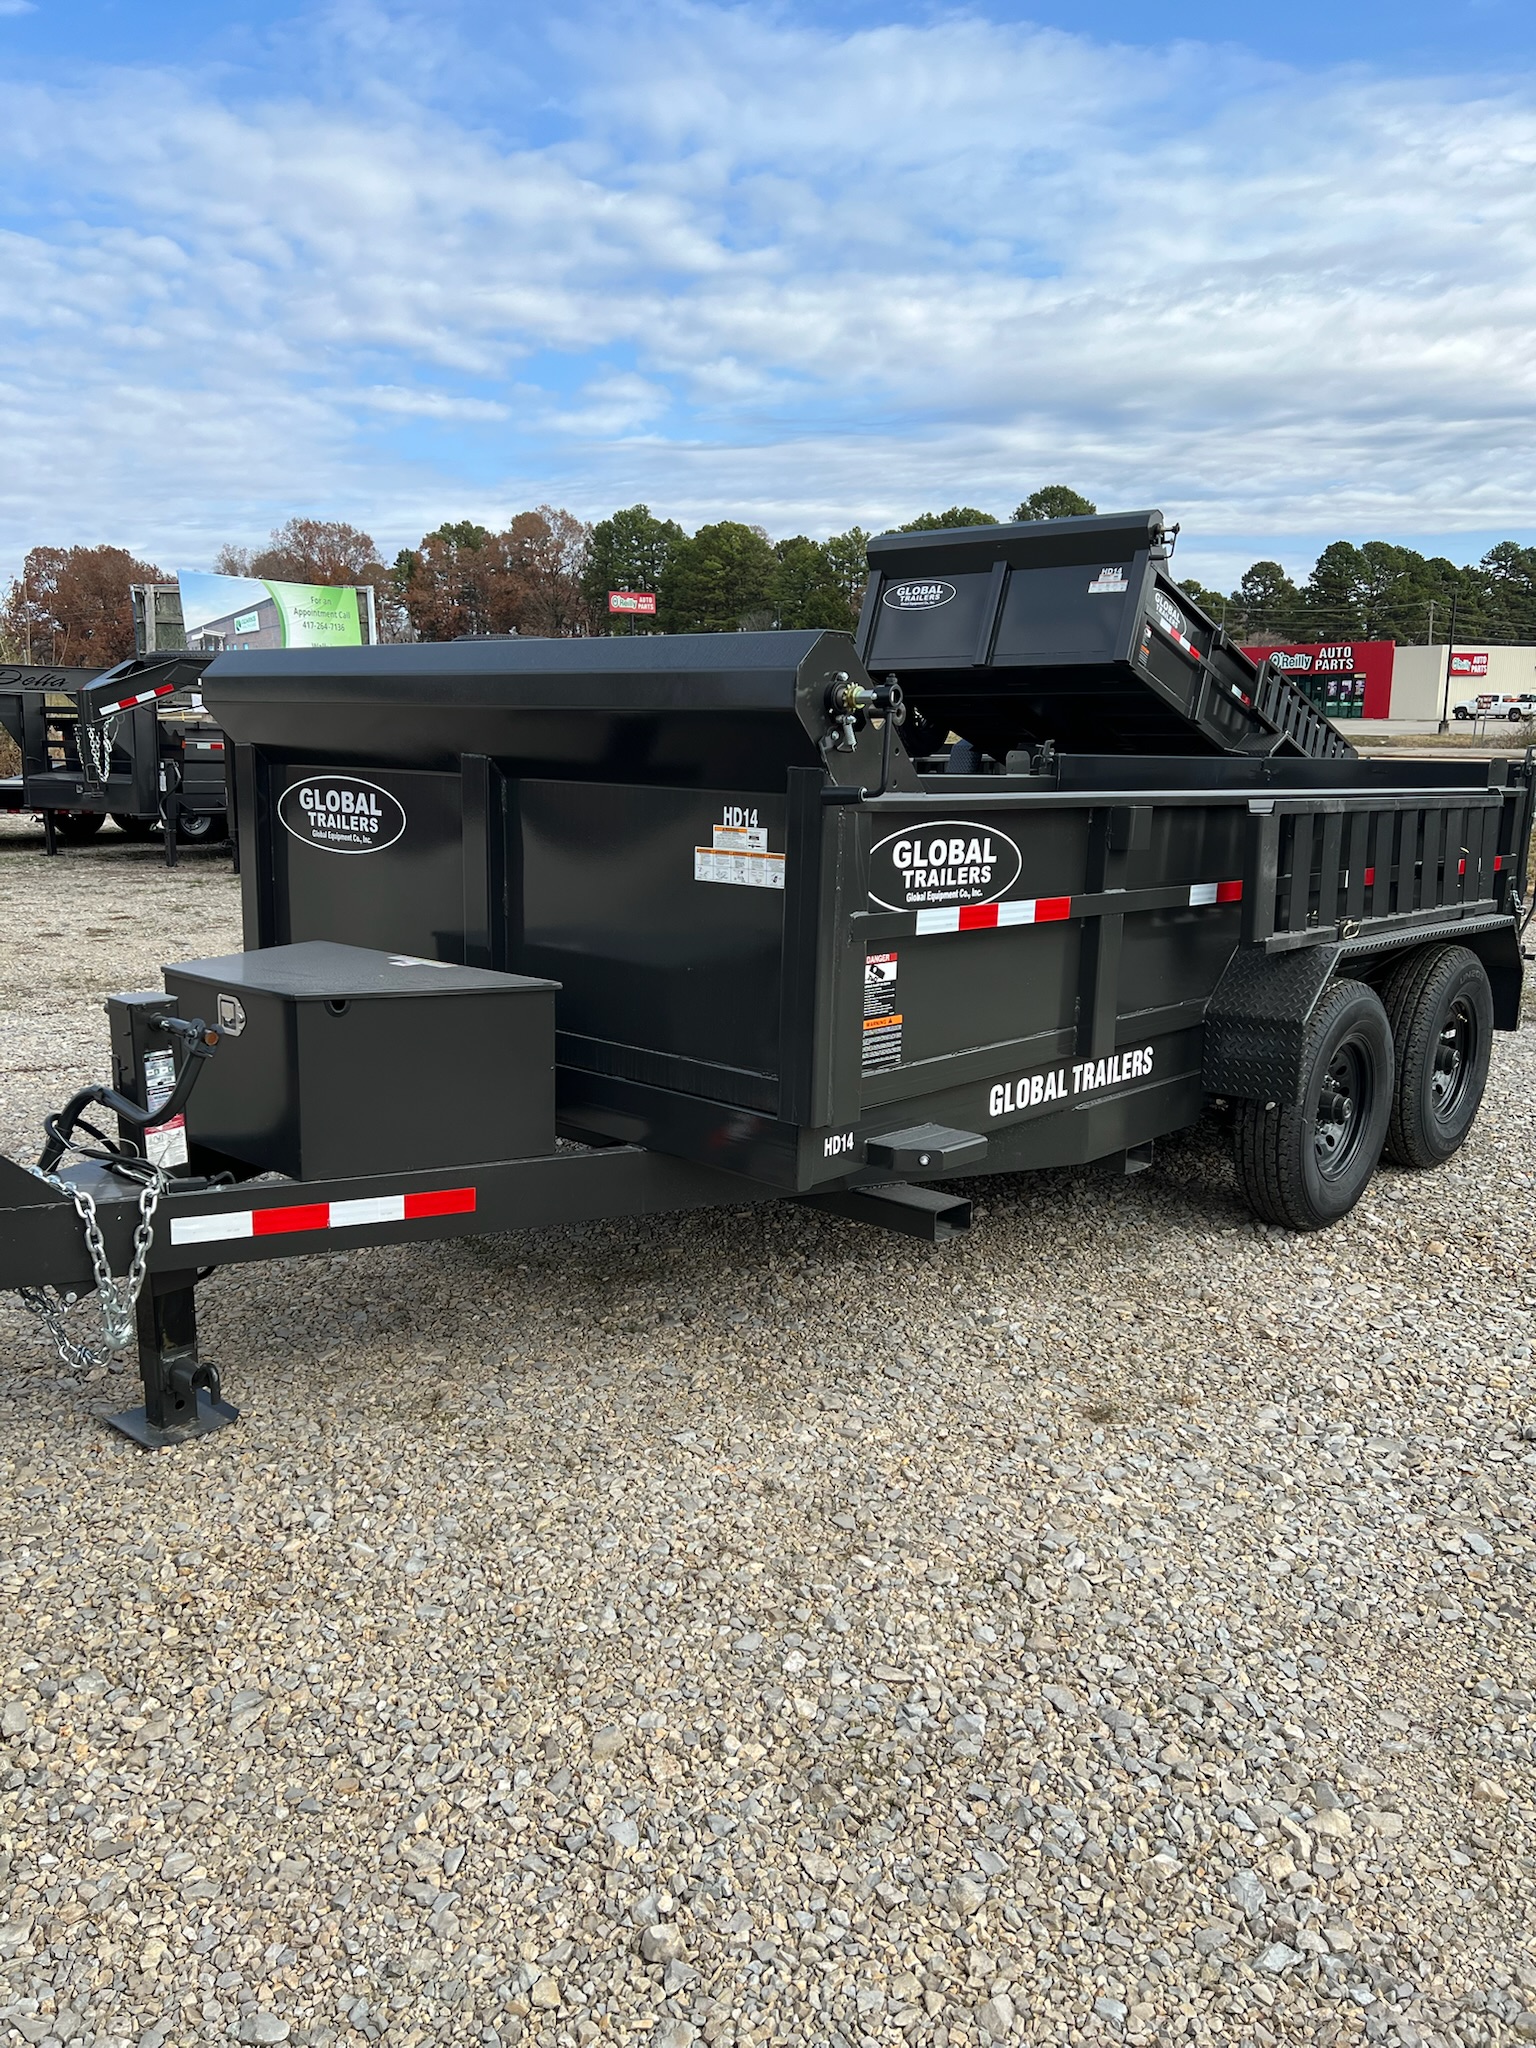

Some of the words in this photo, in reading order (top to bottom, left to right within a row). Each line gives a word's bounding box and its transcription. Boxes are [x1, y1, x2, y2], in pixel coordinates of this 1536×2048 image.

[1101, 567, 1123, 575] HD14
[896, 585, 944, 597] GLOBAL
[900, 594, 940, 602] TRAILERS
[310, 596, 321, 605] For
[611, 594, 638, 609] O'Reilly
[639, 596, 653, 604] AUTO
[293, 607, 338, 618] Appointment
[338, 611, 351, 619] Call
[1154, 592, 1181, 624] GLOBAL
[1155, 603, 1179, 629] TRAILERS
[1319, 646, 1352, 659] AUTO
[1269, 651, 1313, 670] O'Reilly
[1314, 658, 1354, 671] PARTS
[1473, 656, 1488, 665] AUTO
[1471, 664, 1488, 673] PARTS
[0, 668, 70, 687] Delta
[299, 787, 383, 817] GLOBAL
[307, 811, 379, 833] TRAILERS
[723, 806, 759, 828] HD14
[311, 829, 328, 839] Global
[327, 830, 353, 842] Equipment
[362, 834, 373, 844] Inc.
[892, 837, 997, 869] GLOBAL
[902, 865, 992, 889] TRAILERS
[906, 891, 927, 903] Global
[926, 889, 959, 902] Equipment
[971, 888, 983, 898] Inc.
[866, 953, 891, 964] DANGER
[866, 1019, 888, 1028] WARNING
[989, 1068, 1068, 1117] GLOBAL
[1072, 1046, 1154, 1095] TRAILERS
[824, 1131, 855, 1157] HD14
